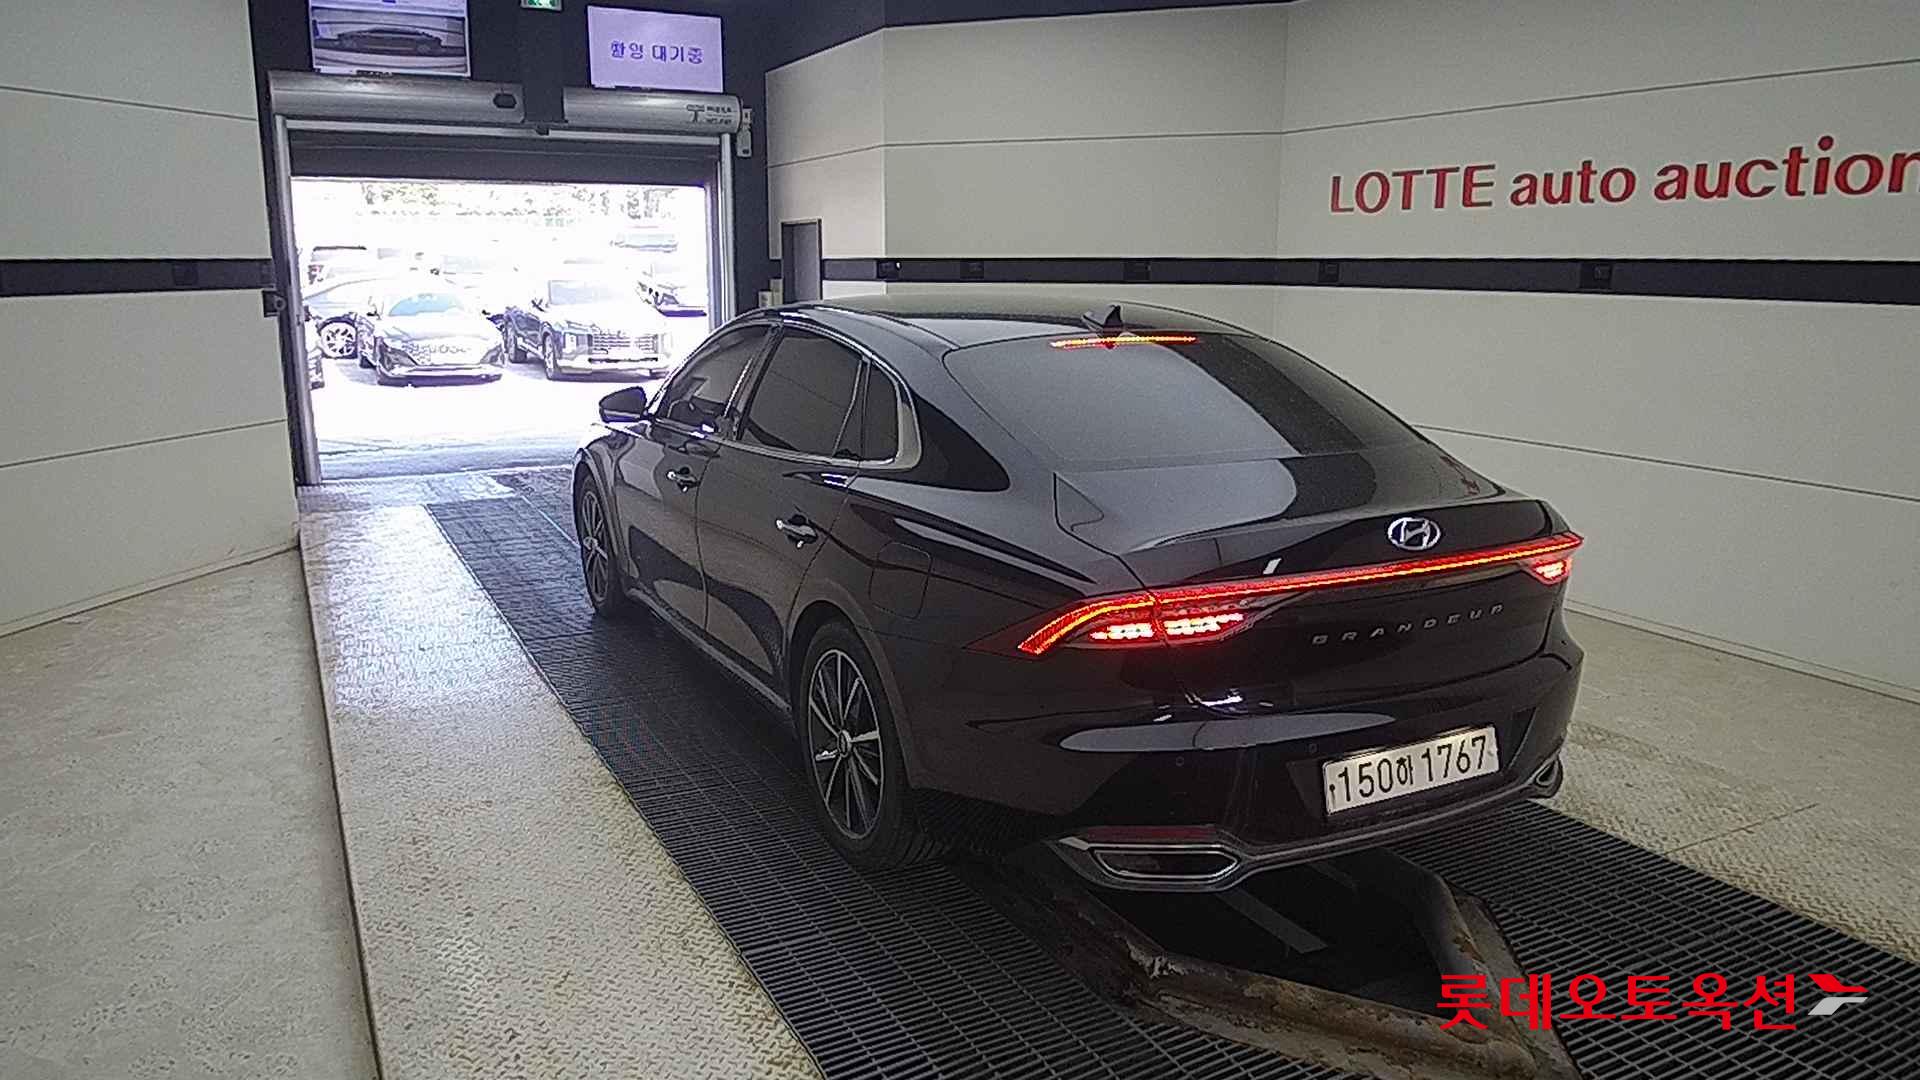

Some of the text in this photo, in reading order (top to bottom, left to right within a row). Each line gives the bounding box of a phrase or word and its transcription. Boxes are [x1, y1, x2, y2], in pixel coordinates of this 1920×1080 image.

[651, 44, 704, 65] 대기중
[1331, 135, 1920, 213] LOTTE auto auction
[1311, 602, 1504, 645] GRANDEUR
[1421, 735, 1487, 782] 1767
